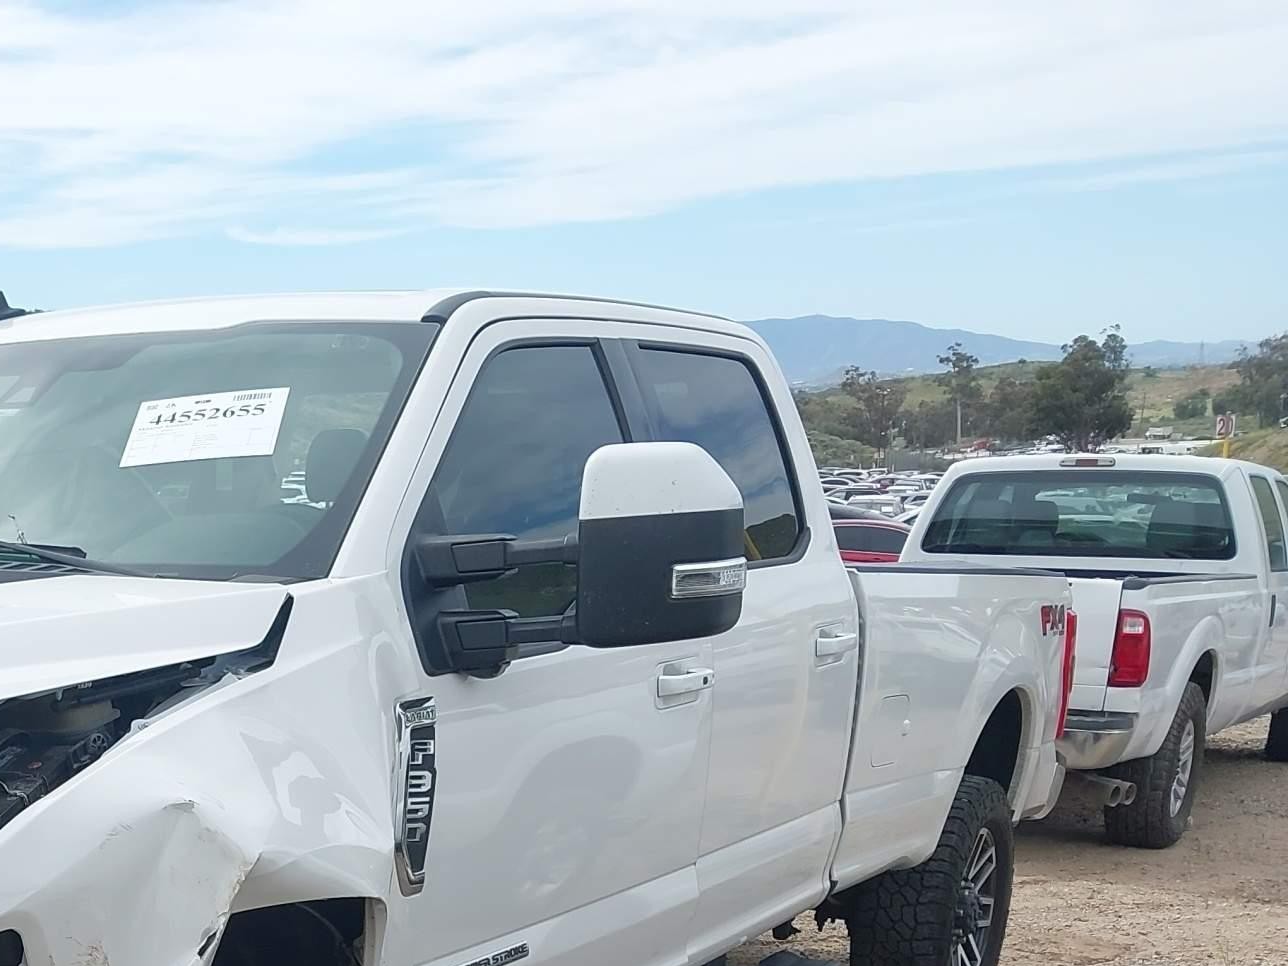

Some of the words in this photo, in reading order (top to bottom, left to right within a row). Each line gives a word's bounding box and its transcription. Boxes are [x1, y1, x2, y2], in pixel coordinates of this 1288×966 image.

[149, 403, 267, 426] 44552655
[1040, 604, 1065, 636] FX4
[491, 942, 528, 965] STROKE
